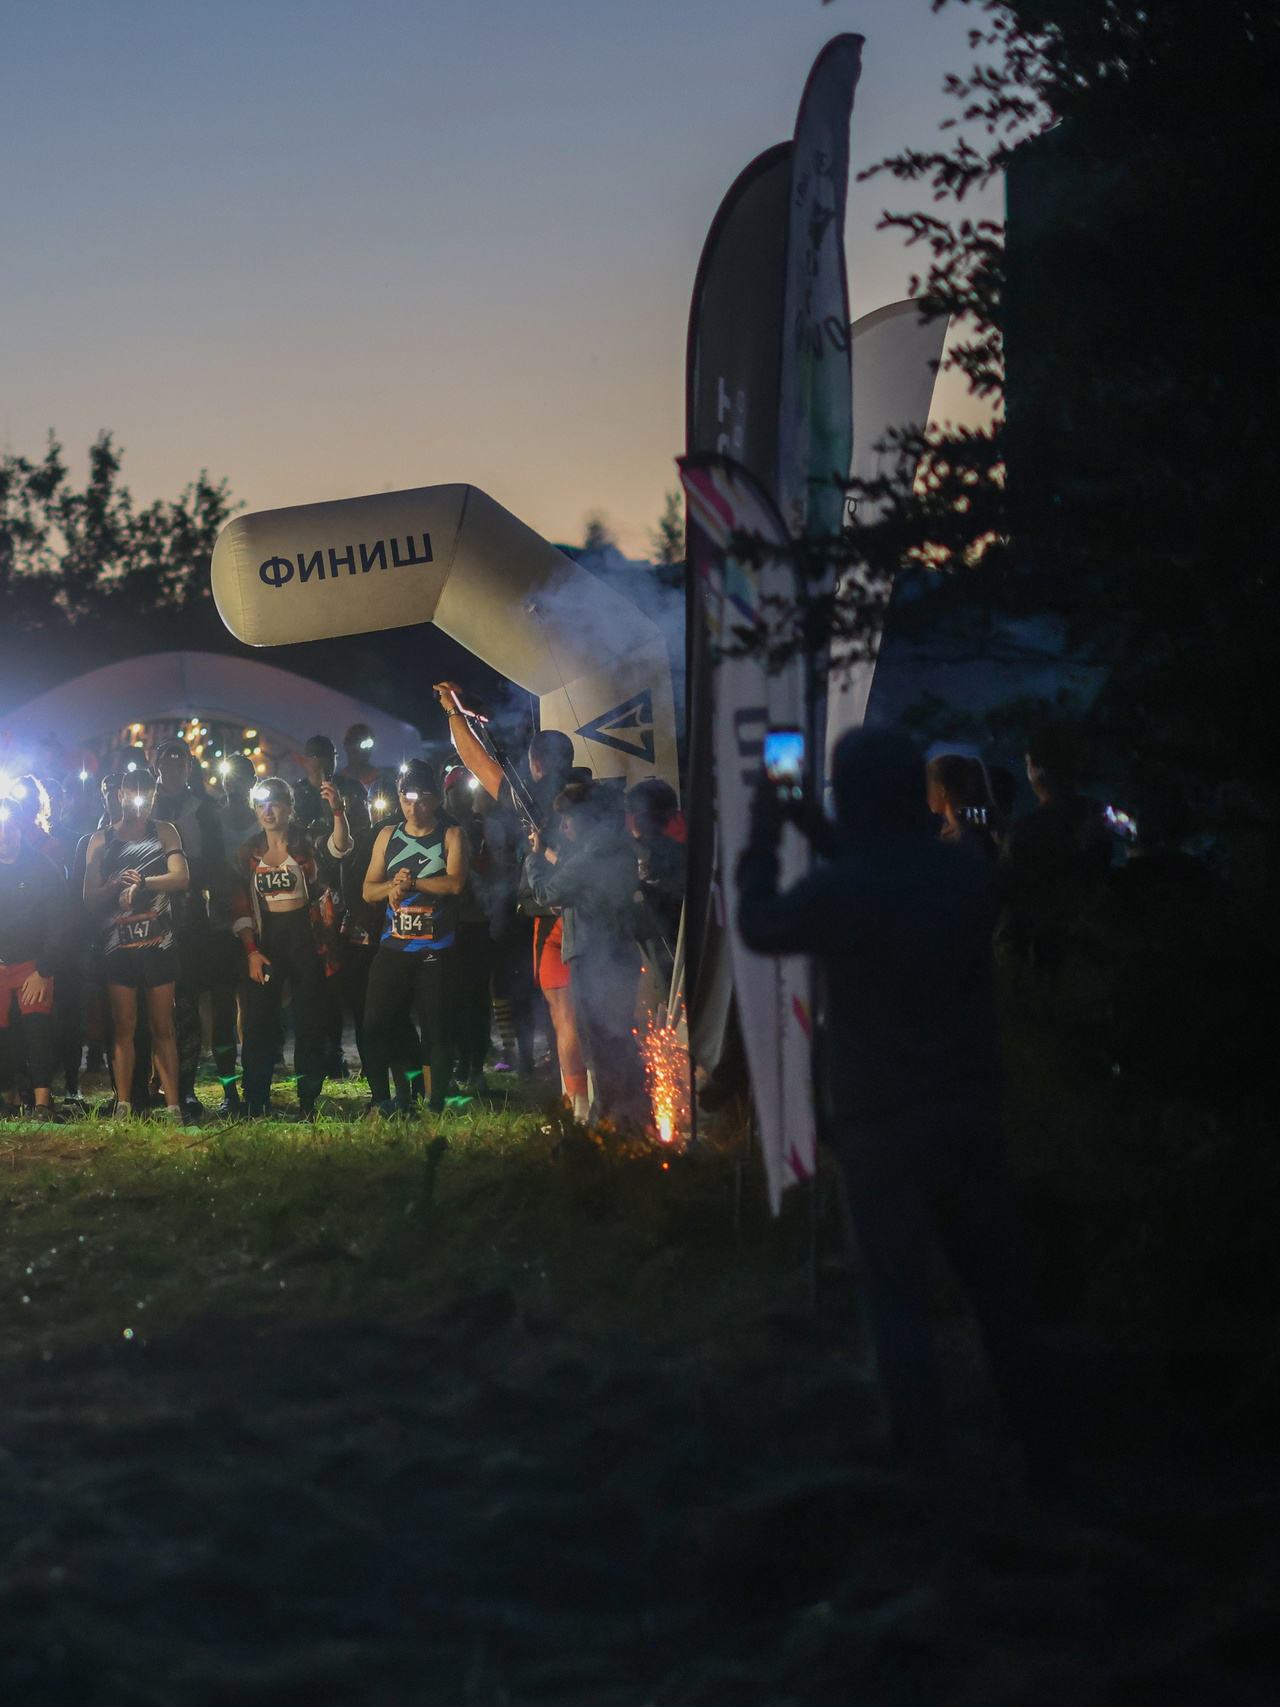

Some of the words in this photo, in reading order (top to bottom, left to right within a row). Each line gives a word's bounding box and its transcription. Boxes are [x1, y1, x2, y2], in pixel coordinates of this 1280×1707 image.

[259, 533, 434, 588] ФИНИШ
[265, 872, 291, 889] 145
[126, 920, 150, 940] 147
[399, 913, 423, 931] 134
